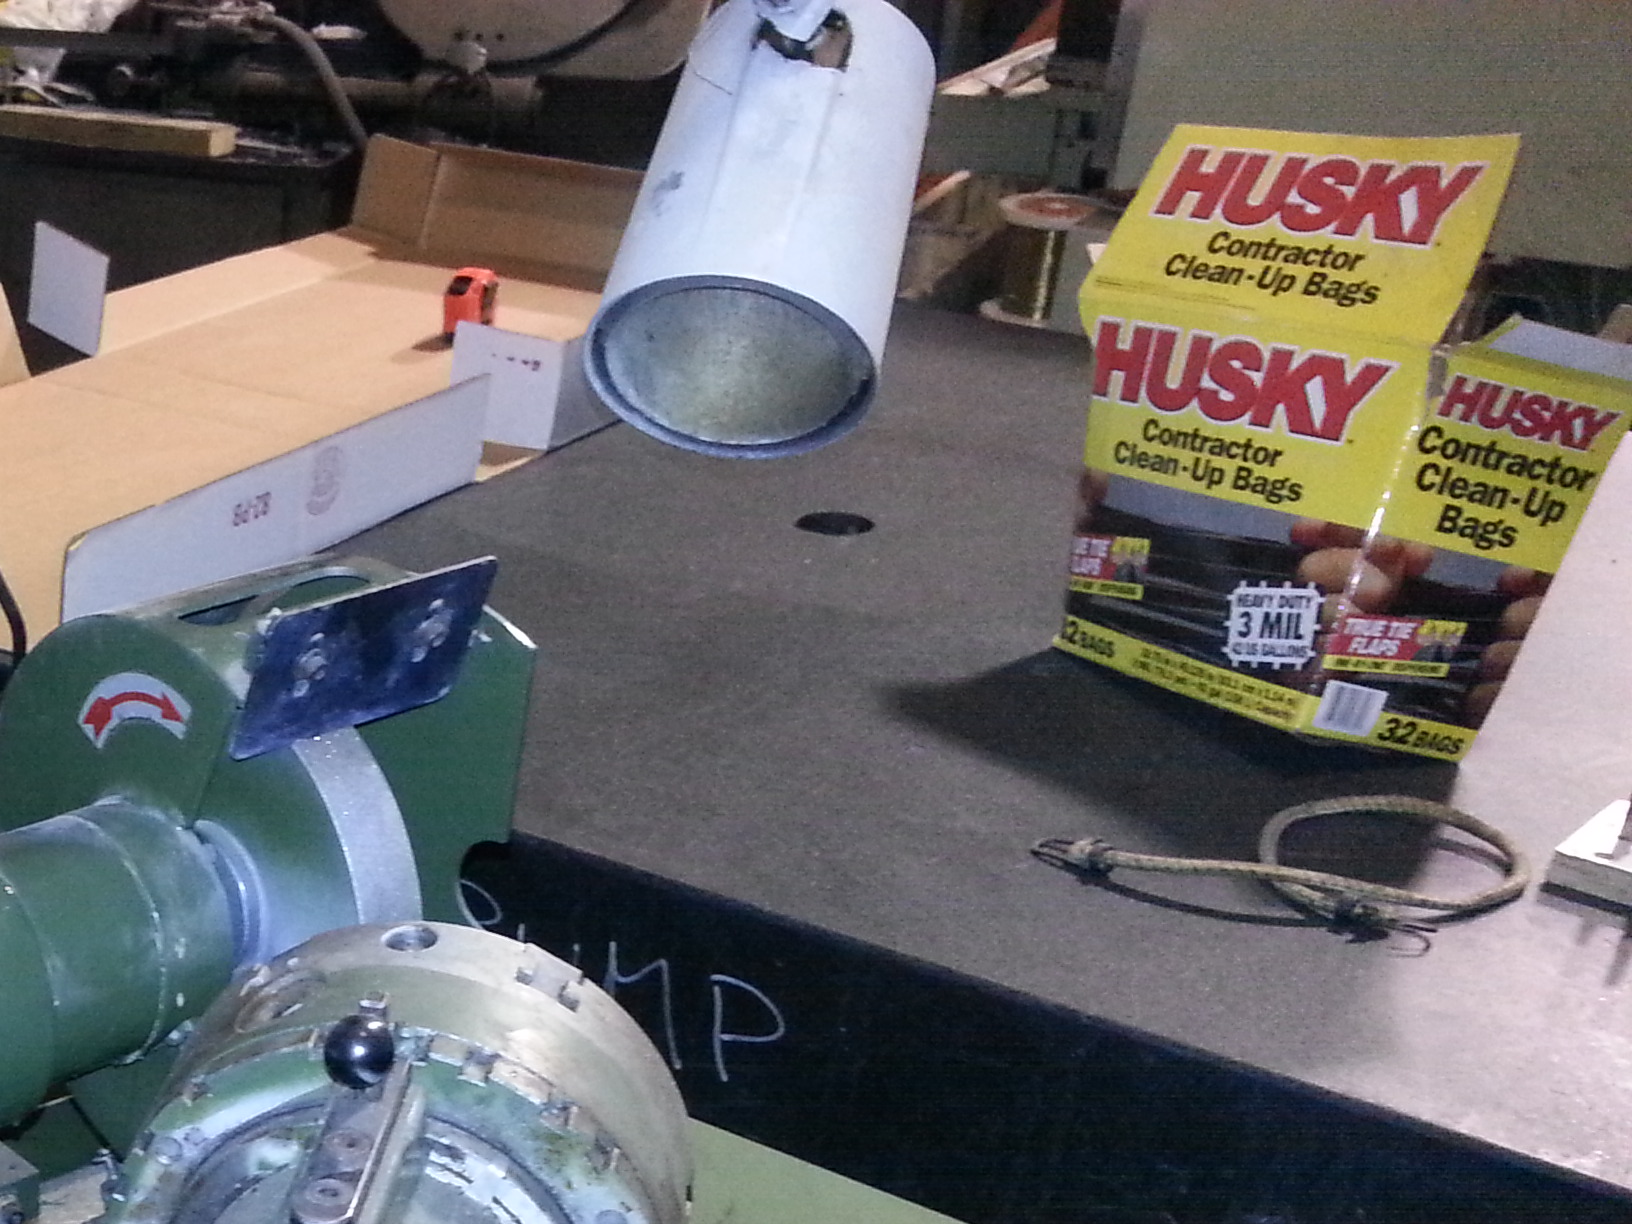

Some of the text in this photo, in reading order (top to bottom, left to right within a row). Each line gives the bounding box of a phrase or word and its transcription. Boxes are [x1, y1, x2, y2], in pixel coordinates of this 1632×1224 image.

[1152, 146, 1488, 247] HUSKY
[1207, 231, 1364, 272] Contractor
[1165, 253, 1295, 296] Clean-Up
[1306, 273, 1381, 307] Bags
[1092, 317, 1398, 444] HUSKY
[1438, 374, 1621, 451] HUSKY
[1142, 419, 1282, 467] Contractor
[1418, 426, 1596, 491] Contractor
[1113, 441, 1303, 504] Clean-Up Bags
[1416, 463, 1567, 526] Clean-Up
[1436, 503, 1519, 550] Bags
[1237, 594, 1313, 608] HEAVY DUTY
[1237, 611, 1304, 640] 3 MIL
[1377, 717, 1465, 755] 32 BAGS
